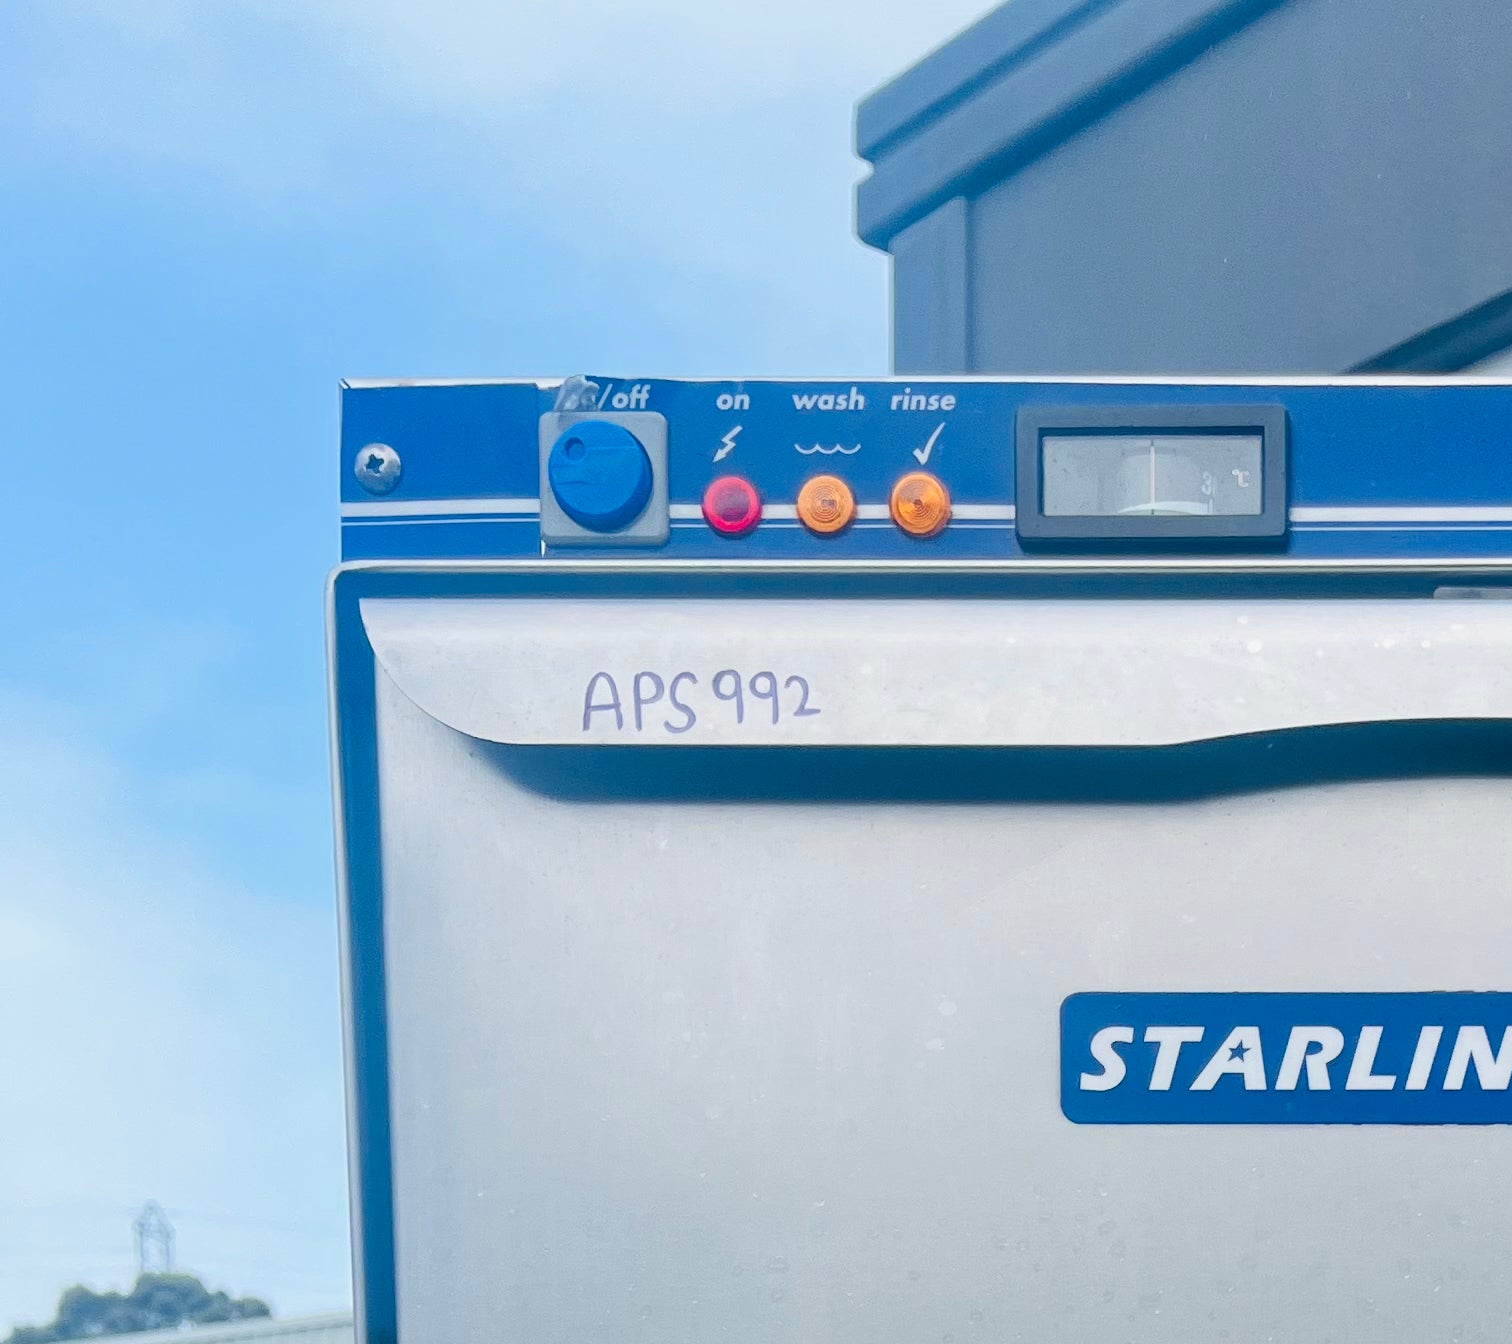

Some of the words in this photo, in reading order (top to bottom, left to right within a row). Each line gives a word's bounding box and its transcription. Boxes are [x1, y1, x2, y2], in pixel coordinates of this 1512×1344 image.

[716, 393, 750, 410] on
[792, 387, 865, 411] wash
[890, 388, 957, 411] rinse
[583, 669, 821, 734] APS992
